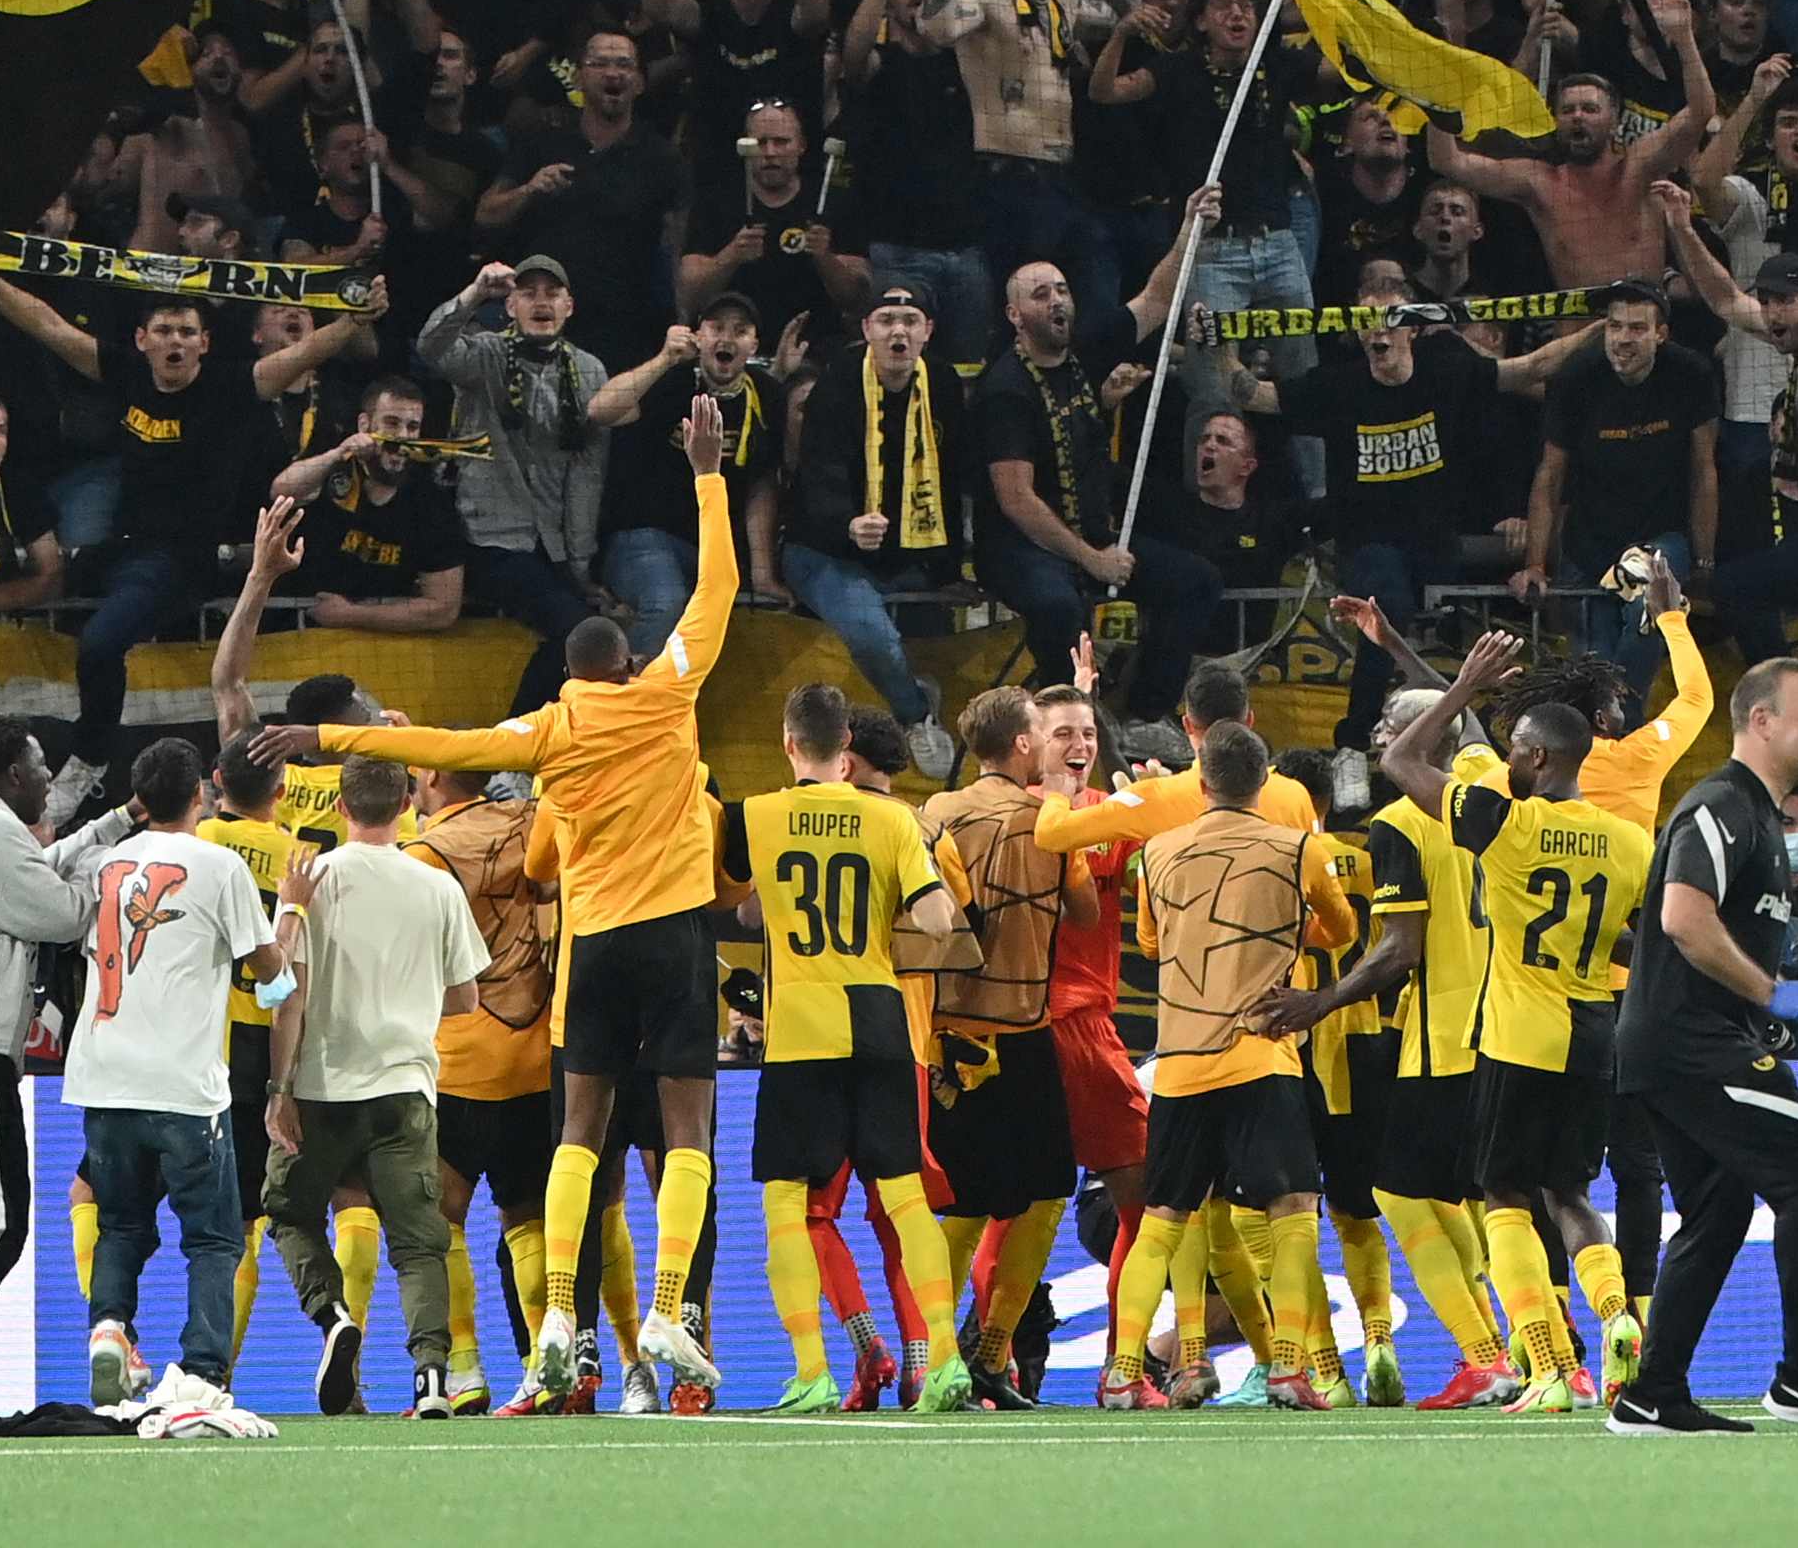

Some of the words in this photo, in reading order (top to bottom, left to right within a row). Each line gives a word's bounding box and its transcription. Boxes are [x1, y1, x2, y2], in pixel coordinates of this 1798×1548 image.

[14, 234, 117, 280] BE
[206, 260, 305, 298] RN
[1220, 306, 1386, 339] URBAN
[1358, 422, 1438, 455] URBAN
[1358, 444, 1443, 476] SQUAD
[788, 811, 862, 838] LAUPER
[1540, 828, 1608, 858] GARCIA
[776, 850, 870, 957] 30
[1522, 867, 1608, 978] 21
